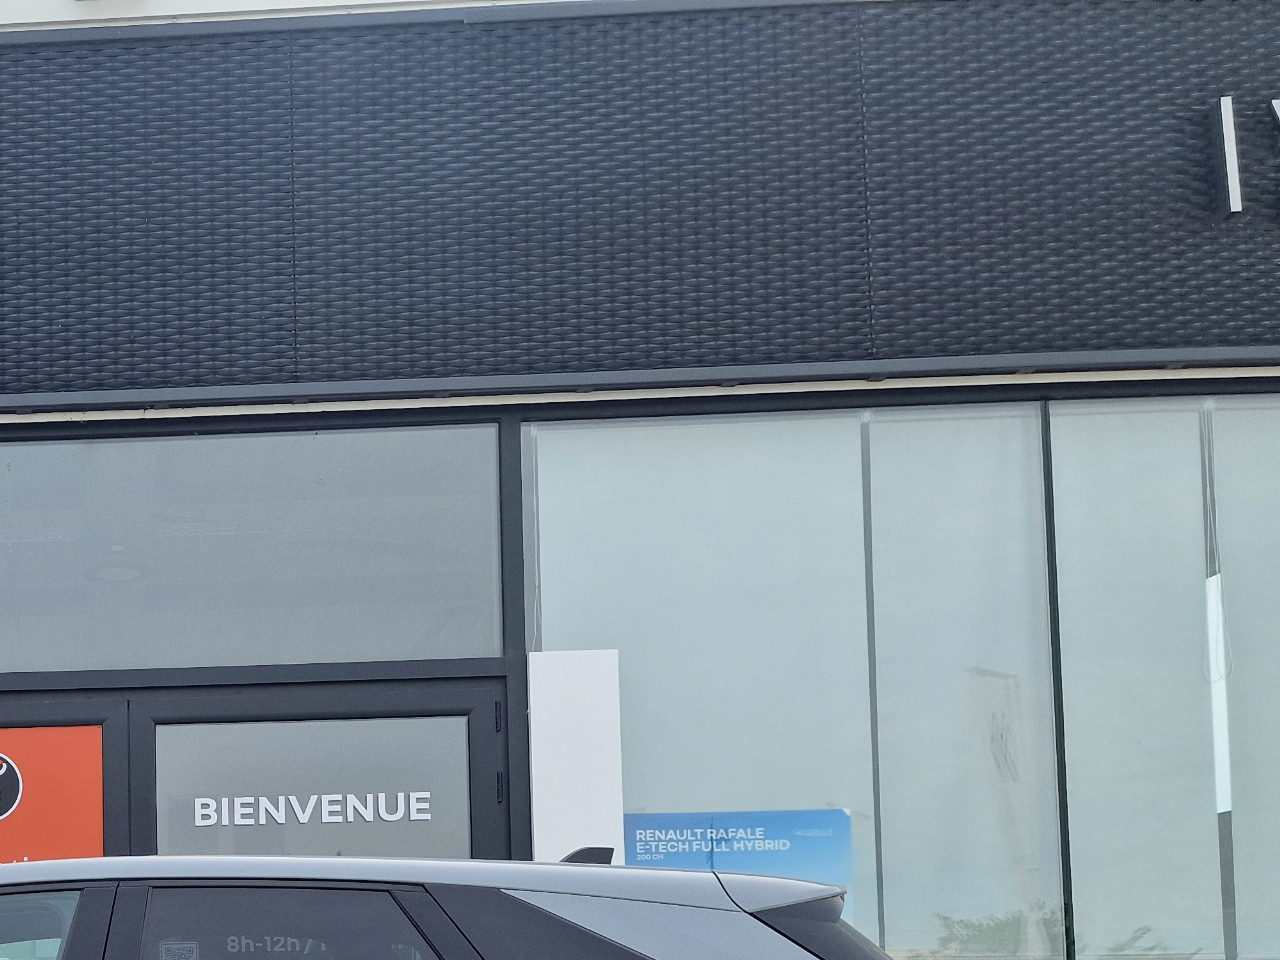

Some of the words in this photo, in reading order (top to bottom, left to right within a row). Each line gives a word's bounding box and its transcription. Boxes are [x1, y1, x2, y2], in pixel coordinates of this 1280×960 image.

[194, 791, 432, 827] BIENVENUE
[636, 828, 704, 841] RENAULT
[707, 827, 764, 840] RAFALE
[636, 841, 689, 853] E-TECH
[692, 840, 730, 852] FULL
[733, 839, 790, 851] HYBRID
[226, 935, 301, 953] 8h-12h
